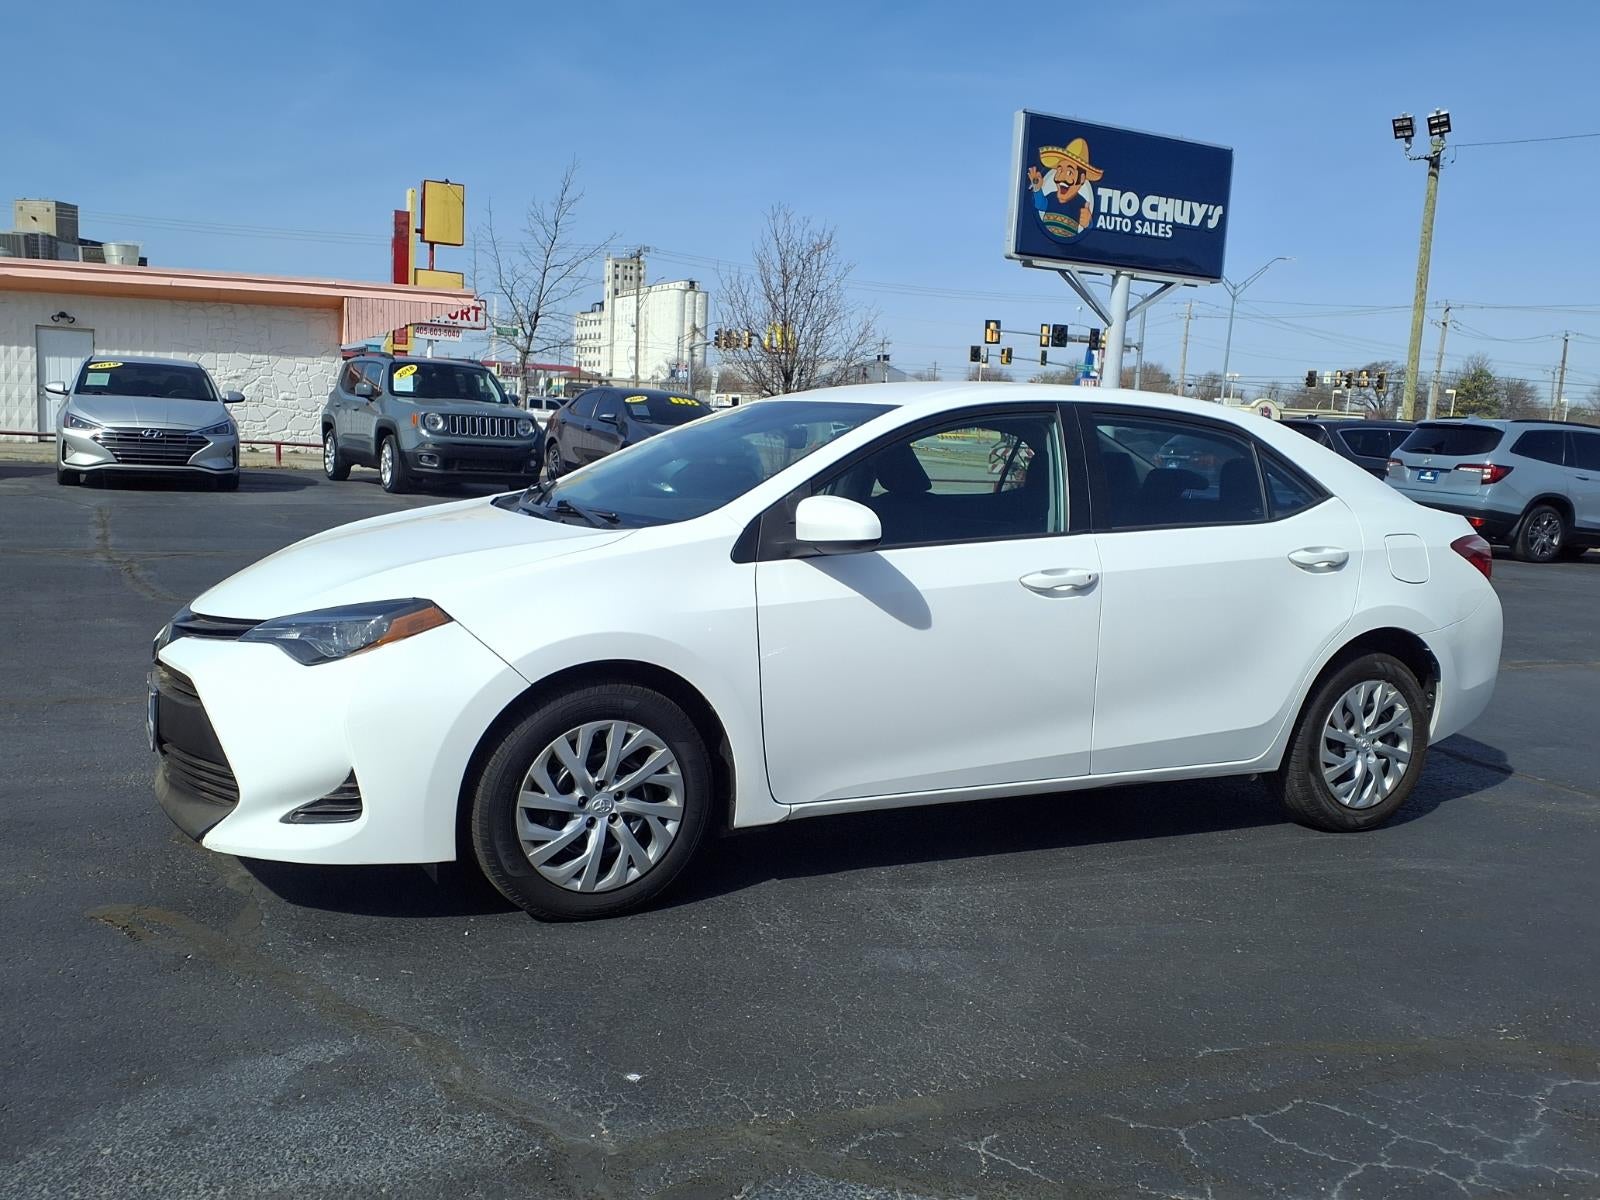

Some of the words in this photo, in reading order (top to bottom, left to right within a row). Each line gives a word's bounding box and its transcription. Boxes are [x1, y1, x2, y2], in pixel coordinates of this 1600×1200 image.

[1097, 187, 1140, 217] TIO
[1142, 195, 1224, 230] CHUY'S
[1096, 214, 1132, 233] AUTO
[1135, 219, 1174, 239] SALES
